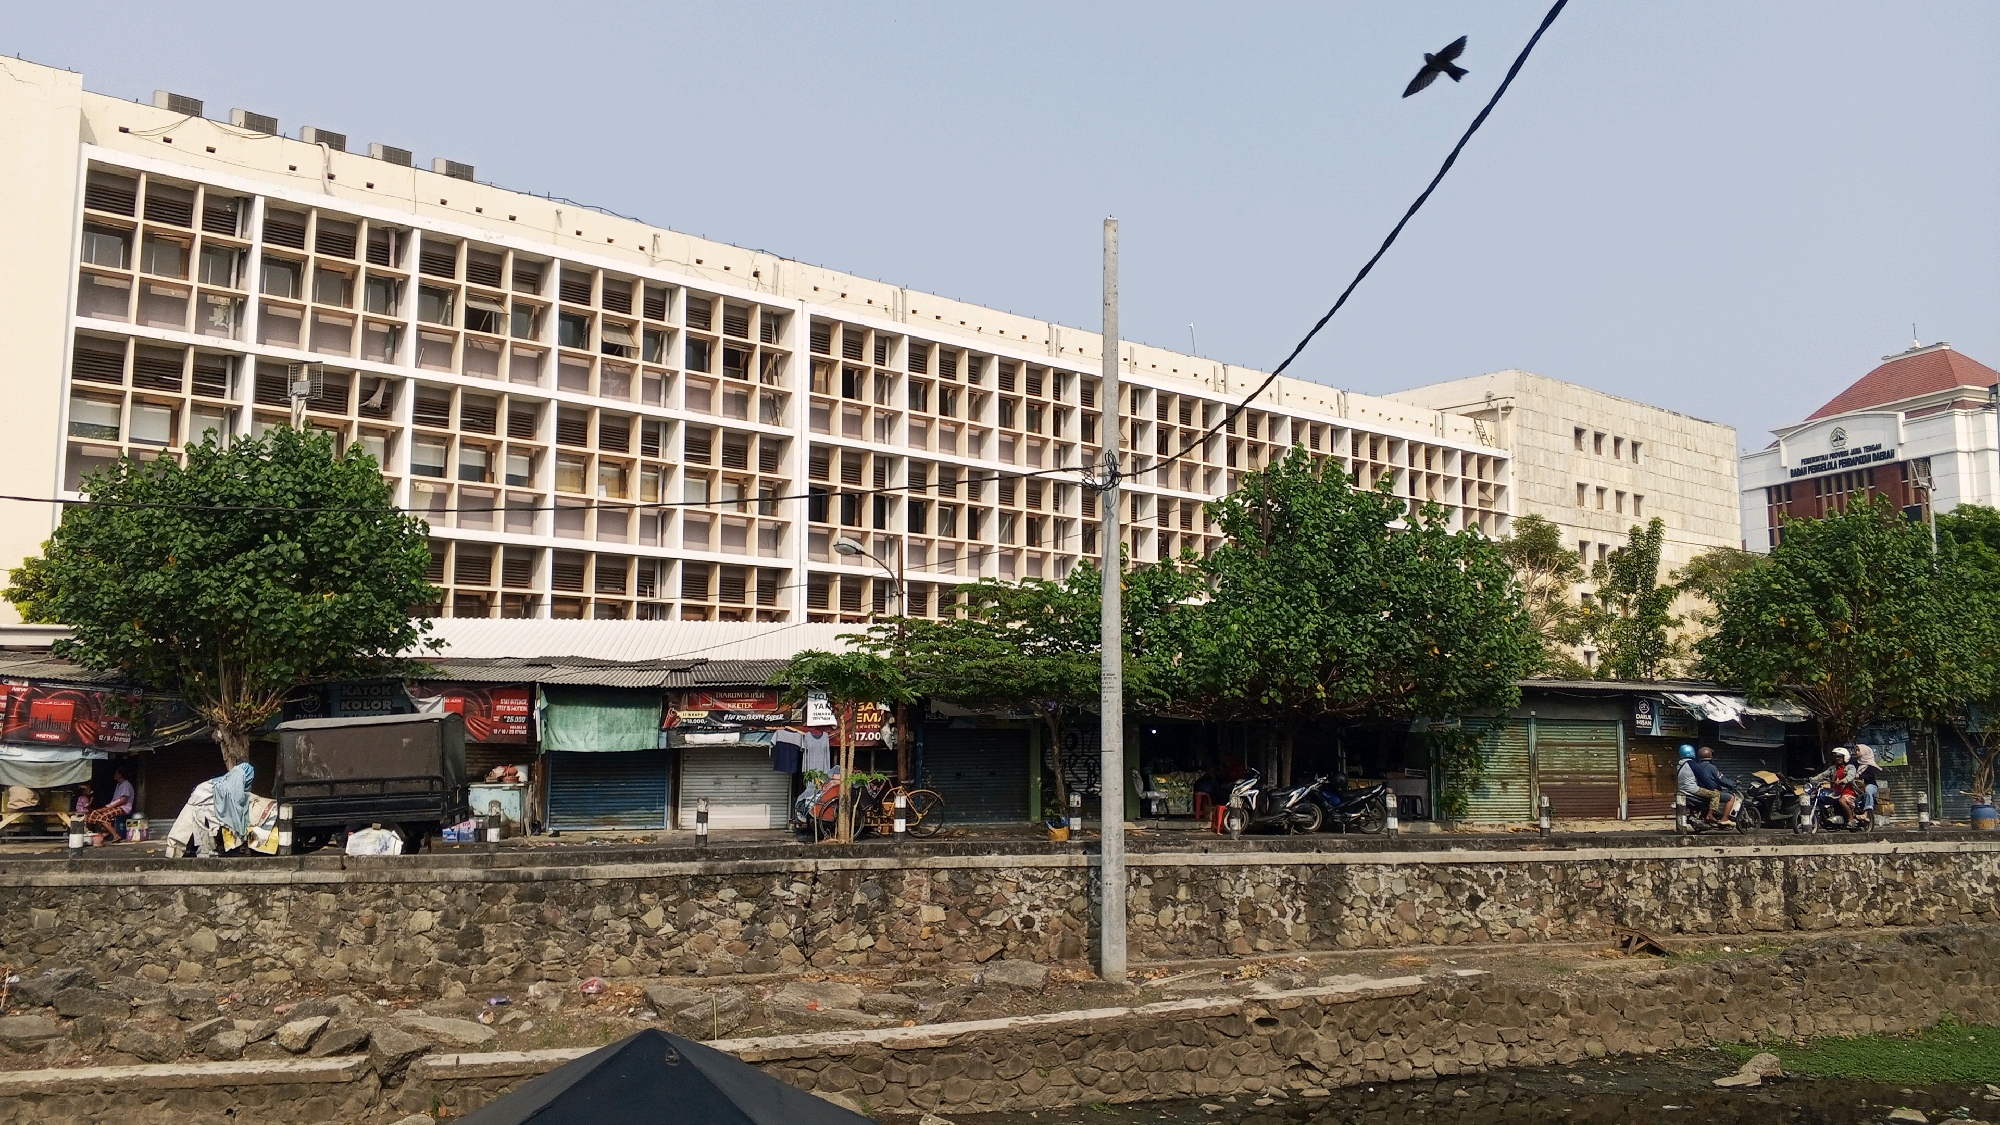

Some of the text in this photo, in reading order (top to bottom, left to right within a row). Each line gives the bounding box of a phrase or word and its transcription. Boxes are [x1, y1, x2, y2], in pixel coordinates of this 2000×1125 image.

[1863, 443, 1882, 454] TENGAH
[1790, 467, 1807, 478] BADAN
[1808, 460, 1838, 474] PENGELOLA
[1872, 449, 1895, 462] DAERAH
[341, 685, 393, 696] KATOK
[340, 700, 393, 711] KOLOR
